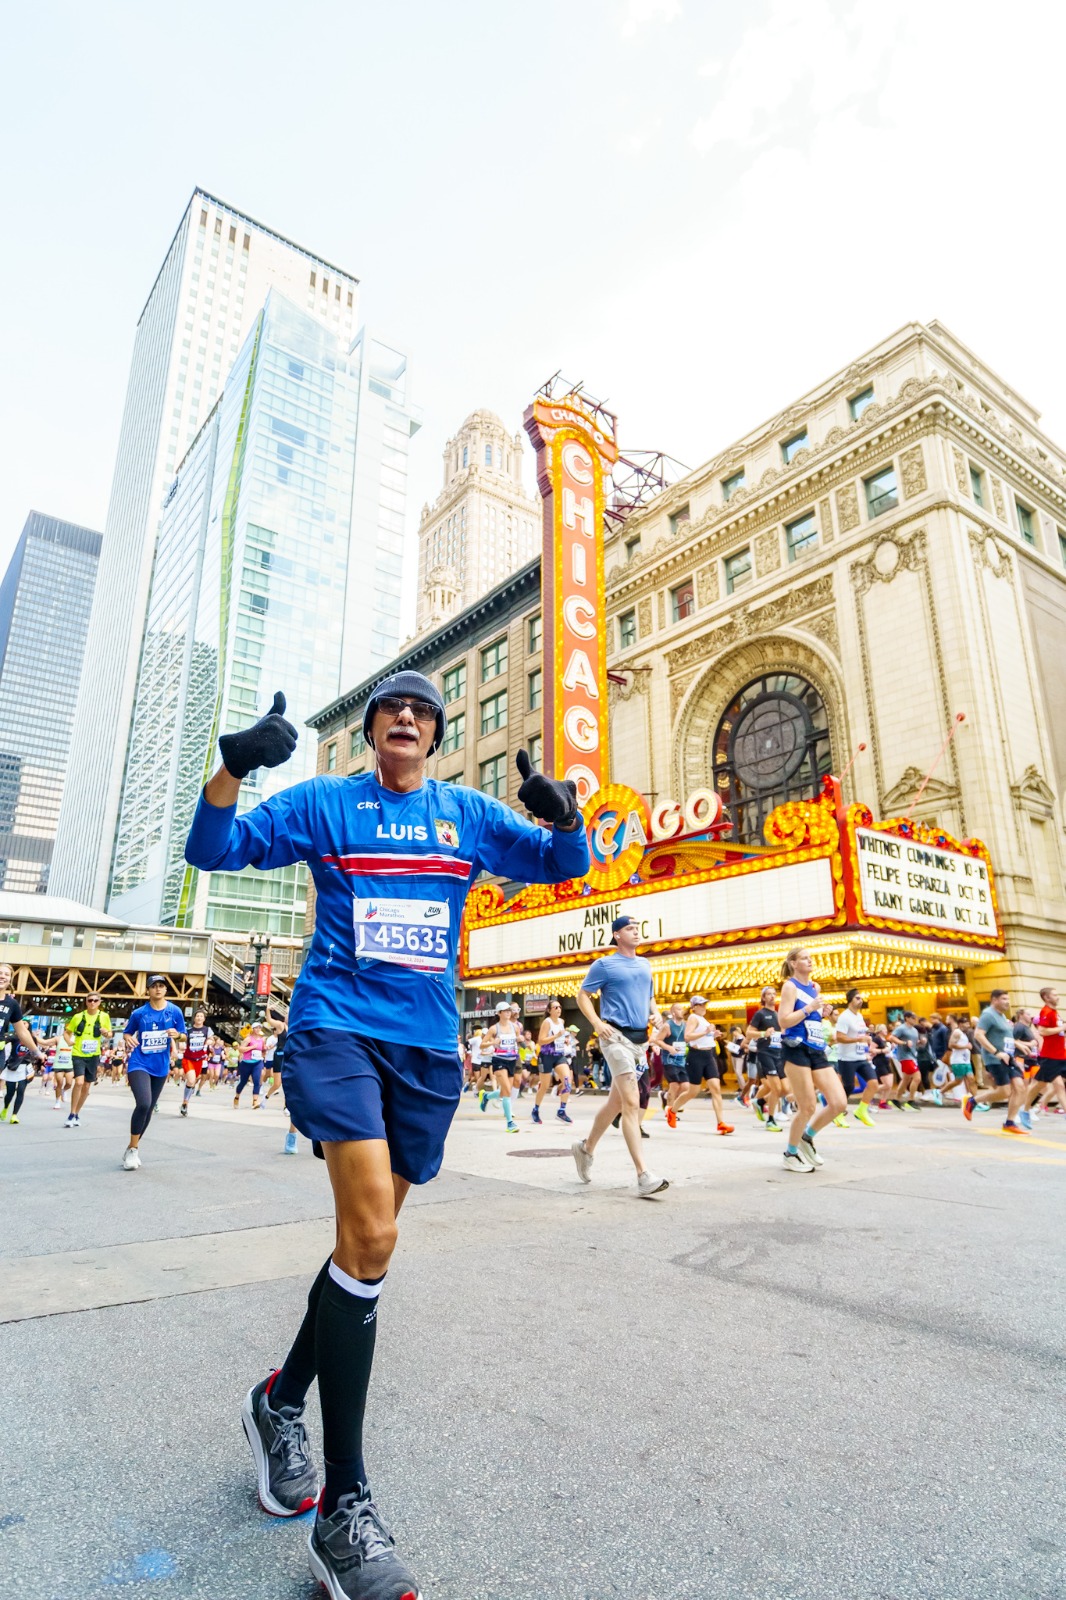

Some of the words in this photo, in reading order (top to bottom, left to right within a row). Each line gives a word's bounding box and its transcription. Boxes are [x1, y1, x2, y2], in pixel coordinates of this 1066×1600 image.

[551, 409, 593, 433] CHASE
[561, 443, 600, 808] CHICAGO
[376, 823, 428, 841] LUIS
[596, 787, 721, 856] CAGO
[860, 834, 902, 859] WHITNEY
[907, 848, 956, 872] CUMMINGS
[867, 862, 901, 885] FELIPE
[907, 872, 951, 896] ESPARZA
[958, 884, 974, 900] OCT
[427, 906, 441, 914] RUN
[874, 890, 903, 911] KANY
[909, 898, 947, 919] GARCIA
[955, 907, 972, 924] OCT
[374, 925, 447, 954] 45635
[559, 932, 583, 952] NOV
[592, 928, 605, 947] 12
